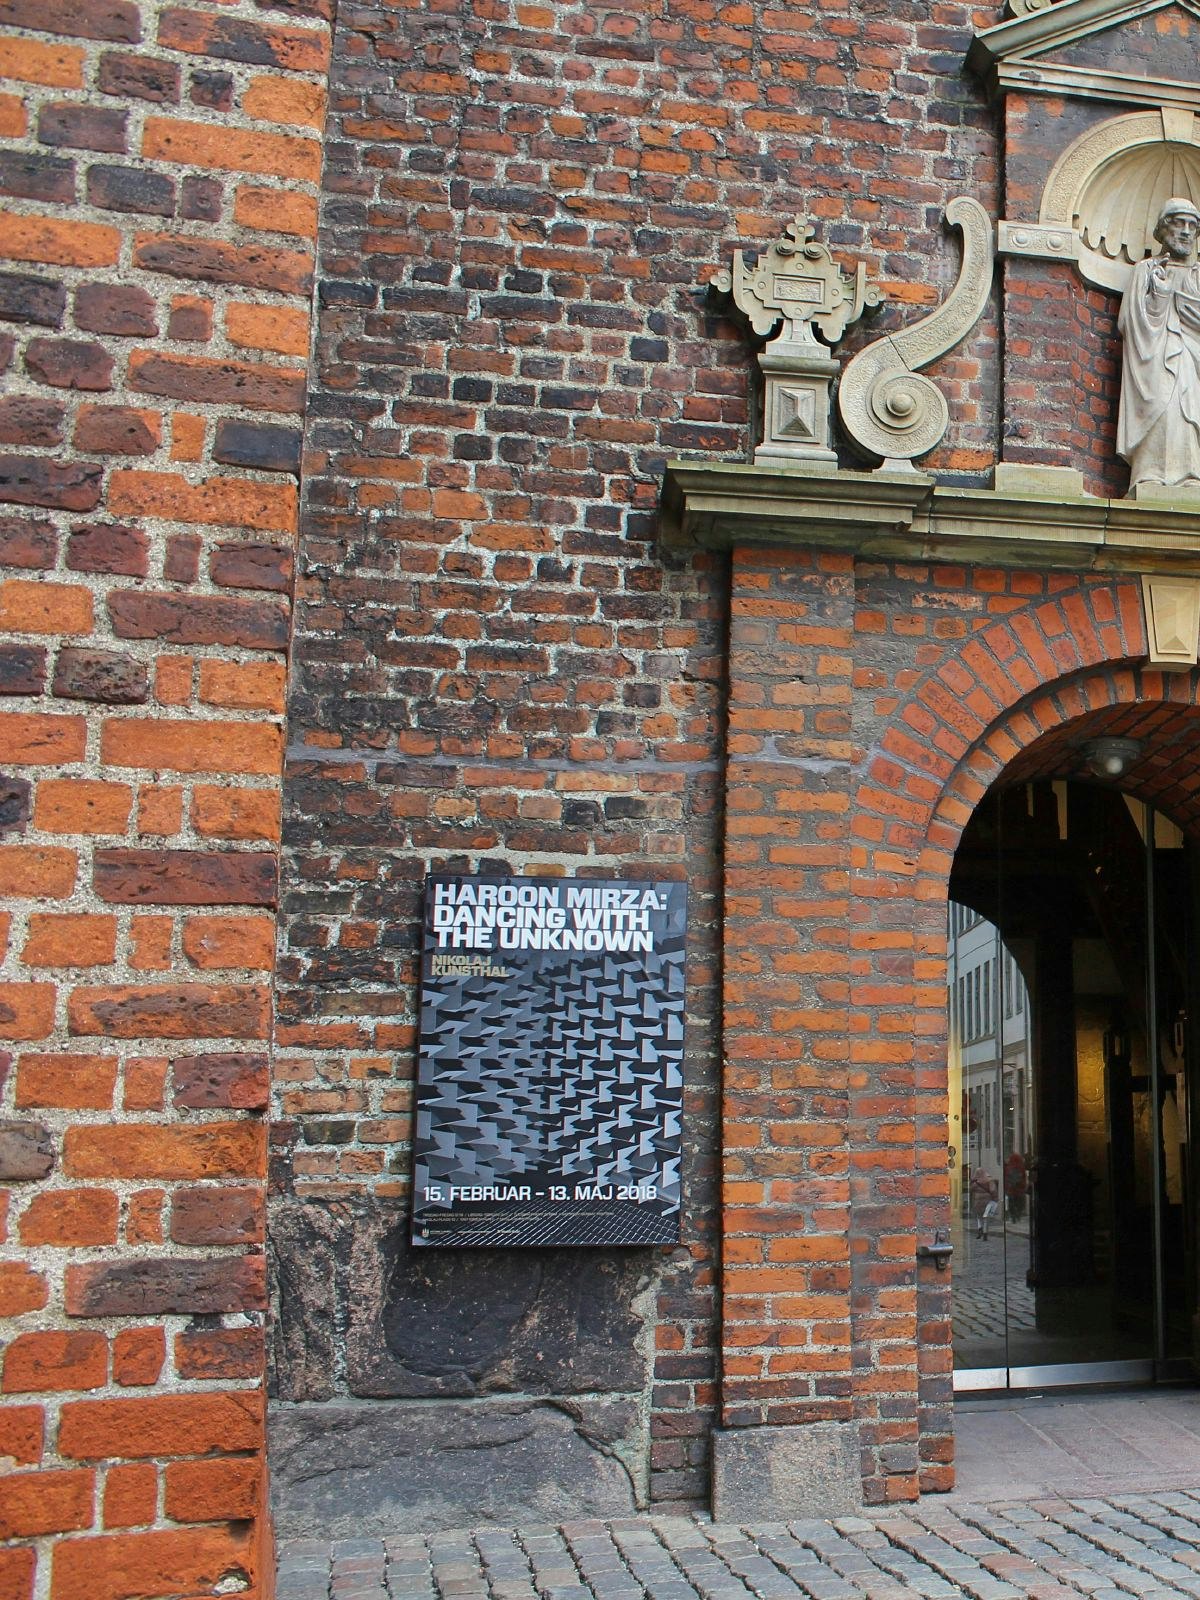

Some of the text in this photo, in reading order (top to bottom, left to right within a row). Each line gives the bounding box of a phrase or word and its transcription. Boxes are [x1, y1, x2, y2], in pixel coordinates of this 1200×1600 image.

[434, 884, 667, 910] HAROON MIRZA:
[433, 905, 649, 931] DANCING WITH
[433, 926, 653, 952] THE UNKNOWN
[431, 955, 492, 966] NIKOLAJ
[431, 966, 510, 977] KUNSTHAL
[423, 1186, 445, 1201] 15.
[450, 1185, 531, 1201] FEBRUAR
[548, 1185, 571, 1201] 13.
[575, 1185, 613, 1201] MAJ
[617, 1185, 657, 1201] 2018
